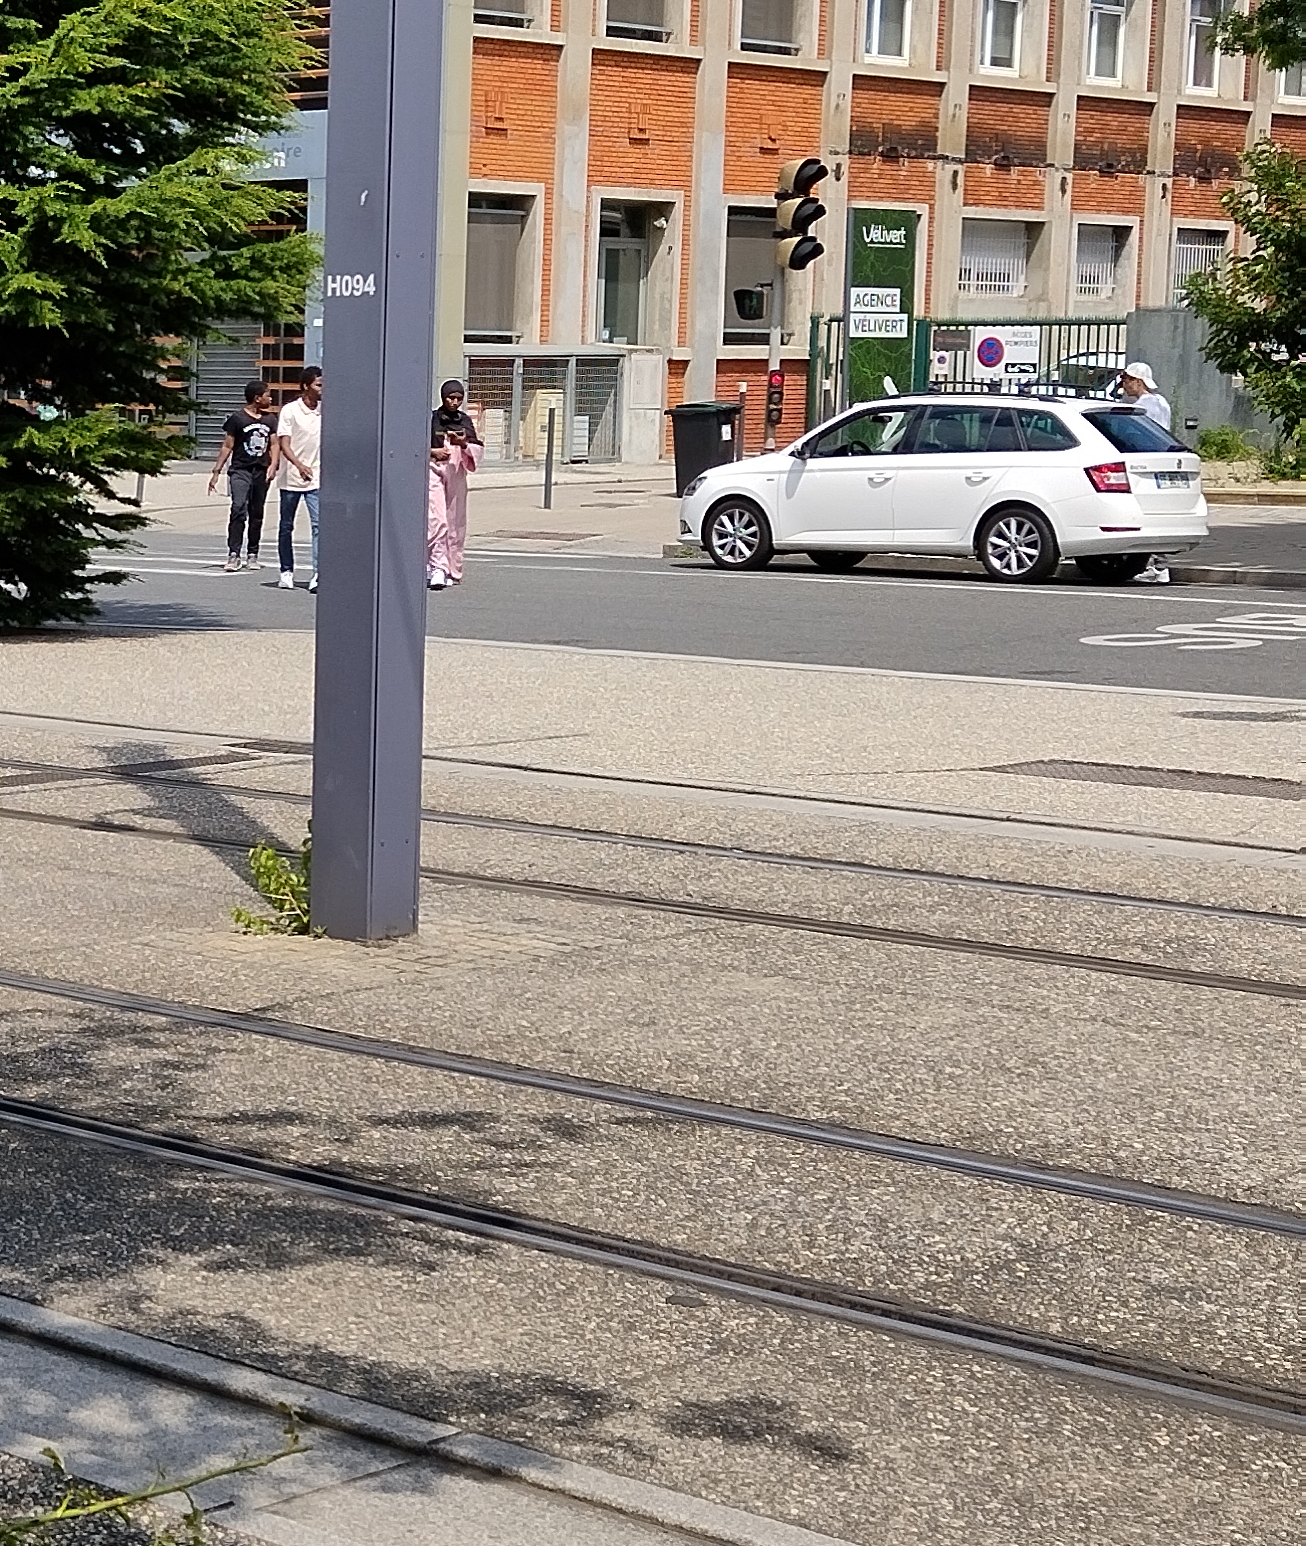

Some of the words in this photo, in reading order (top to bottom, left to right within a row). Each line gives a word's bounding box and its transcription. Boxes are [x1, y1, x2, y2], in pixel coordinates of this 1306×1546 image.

[862, 224, 906, 243] Vélivert
[327, 273, 376, 297] H094
[853, 293, 898, 308] AGENCE
[853, 315, 905, 333] VÉLIVERT
